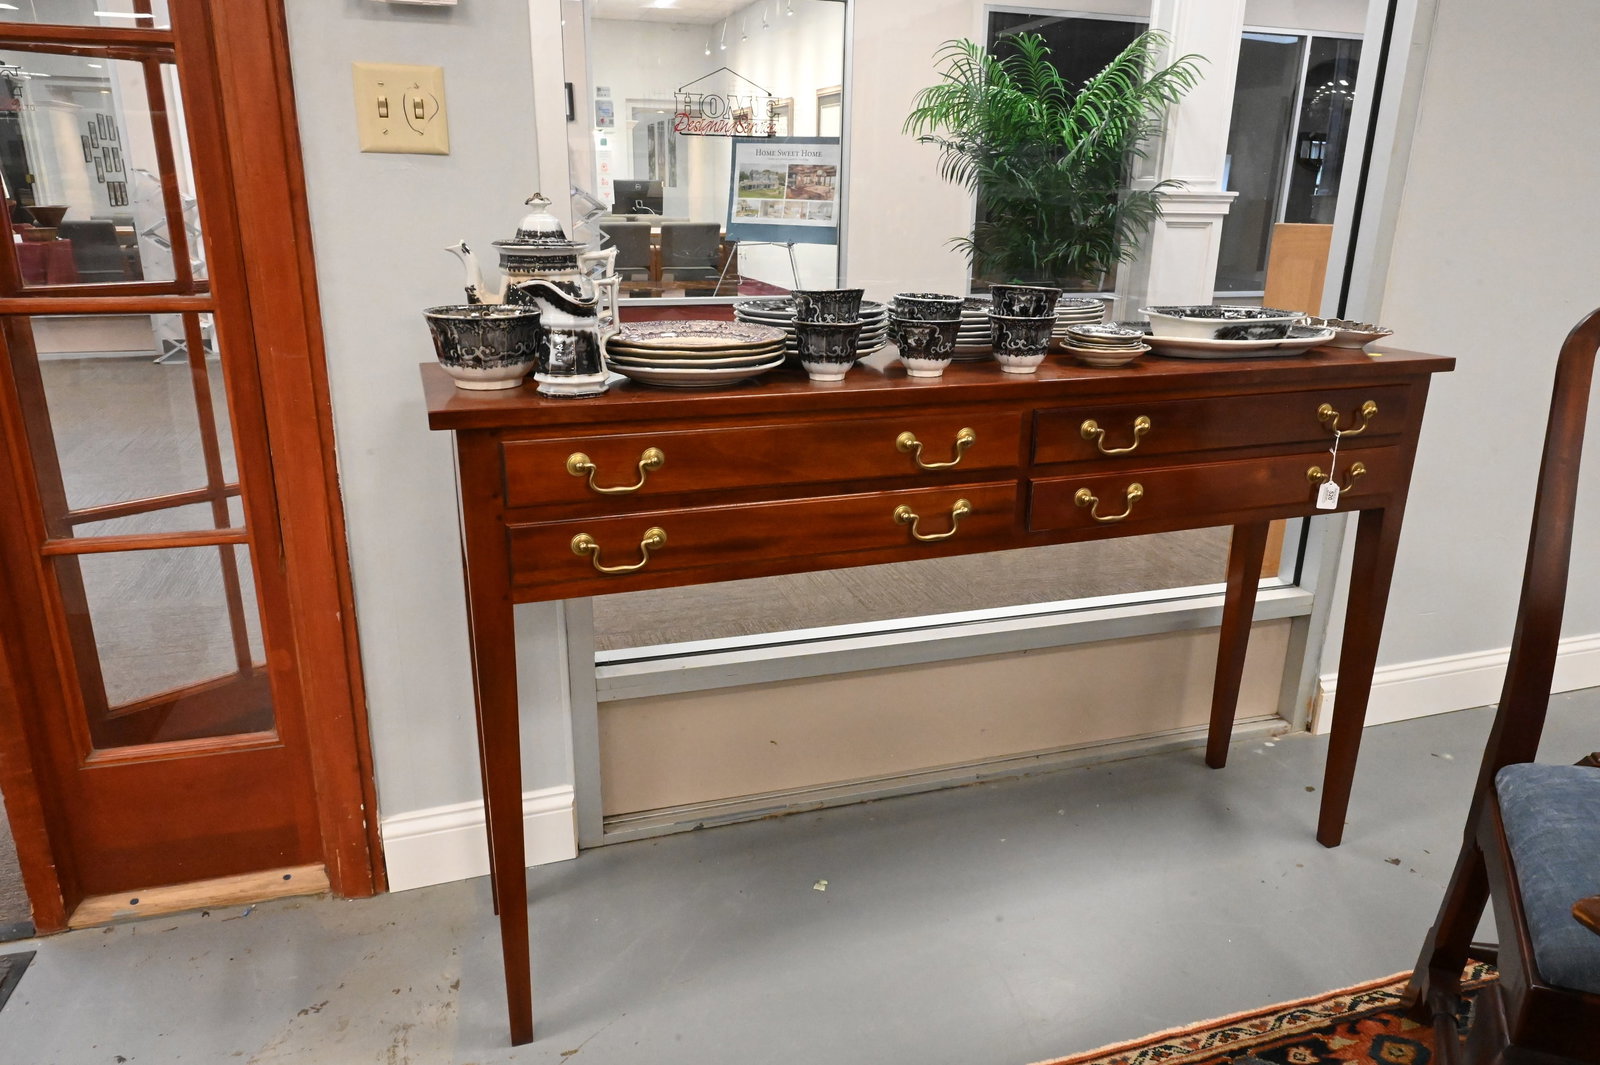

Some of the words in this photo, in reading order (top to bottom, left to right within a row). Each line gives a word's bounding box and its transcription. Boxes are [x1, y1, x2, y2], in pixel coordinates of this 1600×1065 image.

[674, 92, 780, 121] HOME
[755, 148, 776, 157] HOME
[777, 149, 800, 157] SWEET
[801, 149, 823, 158] HOME
